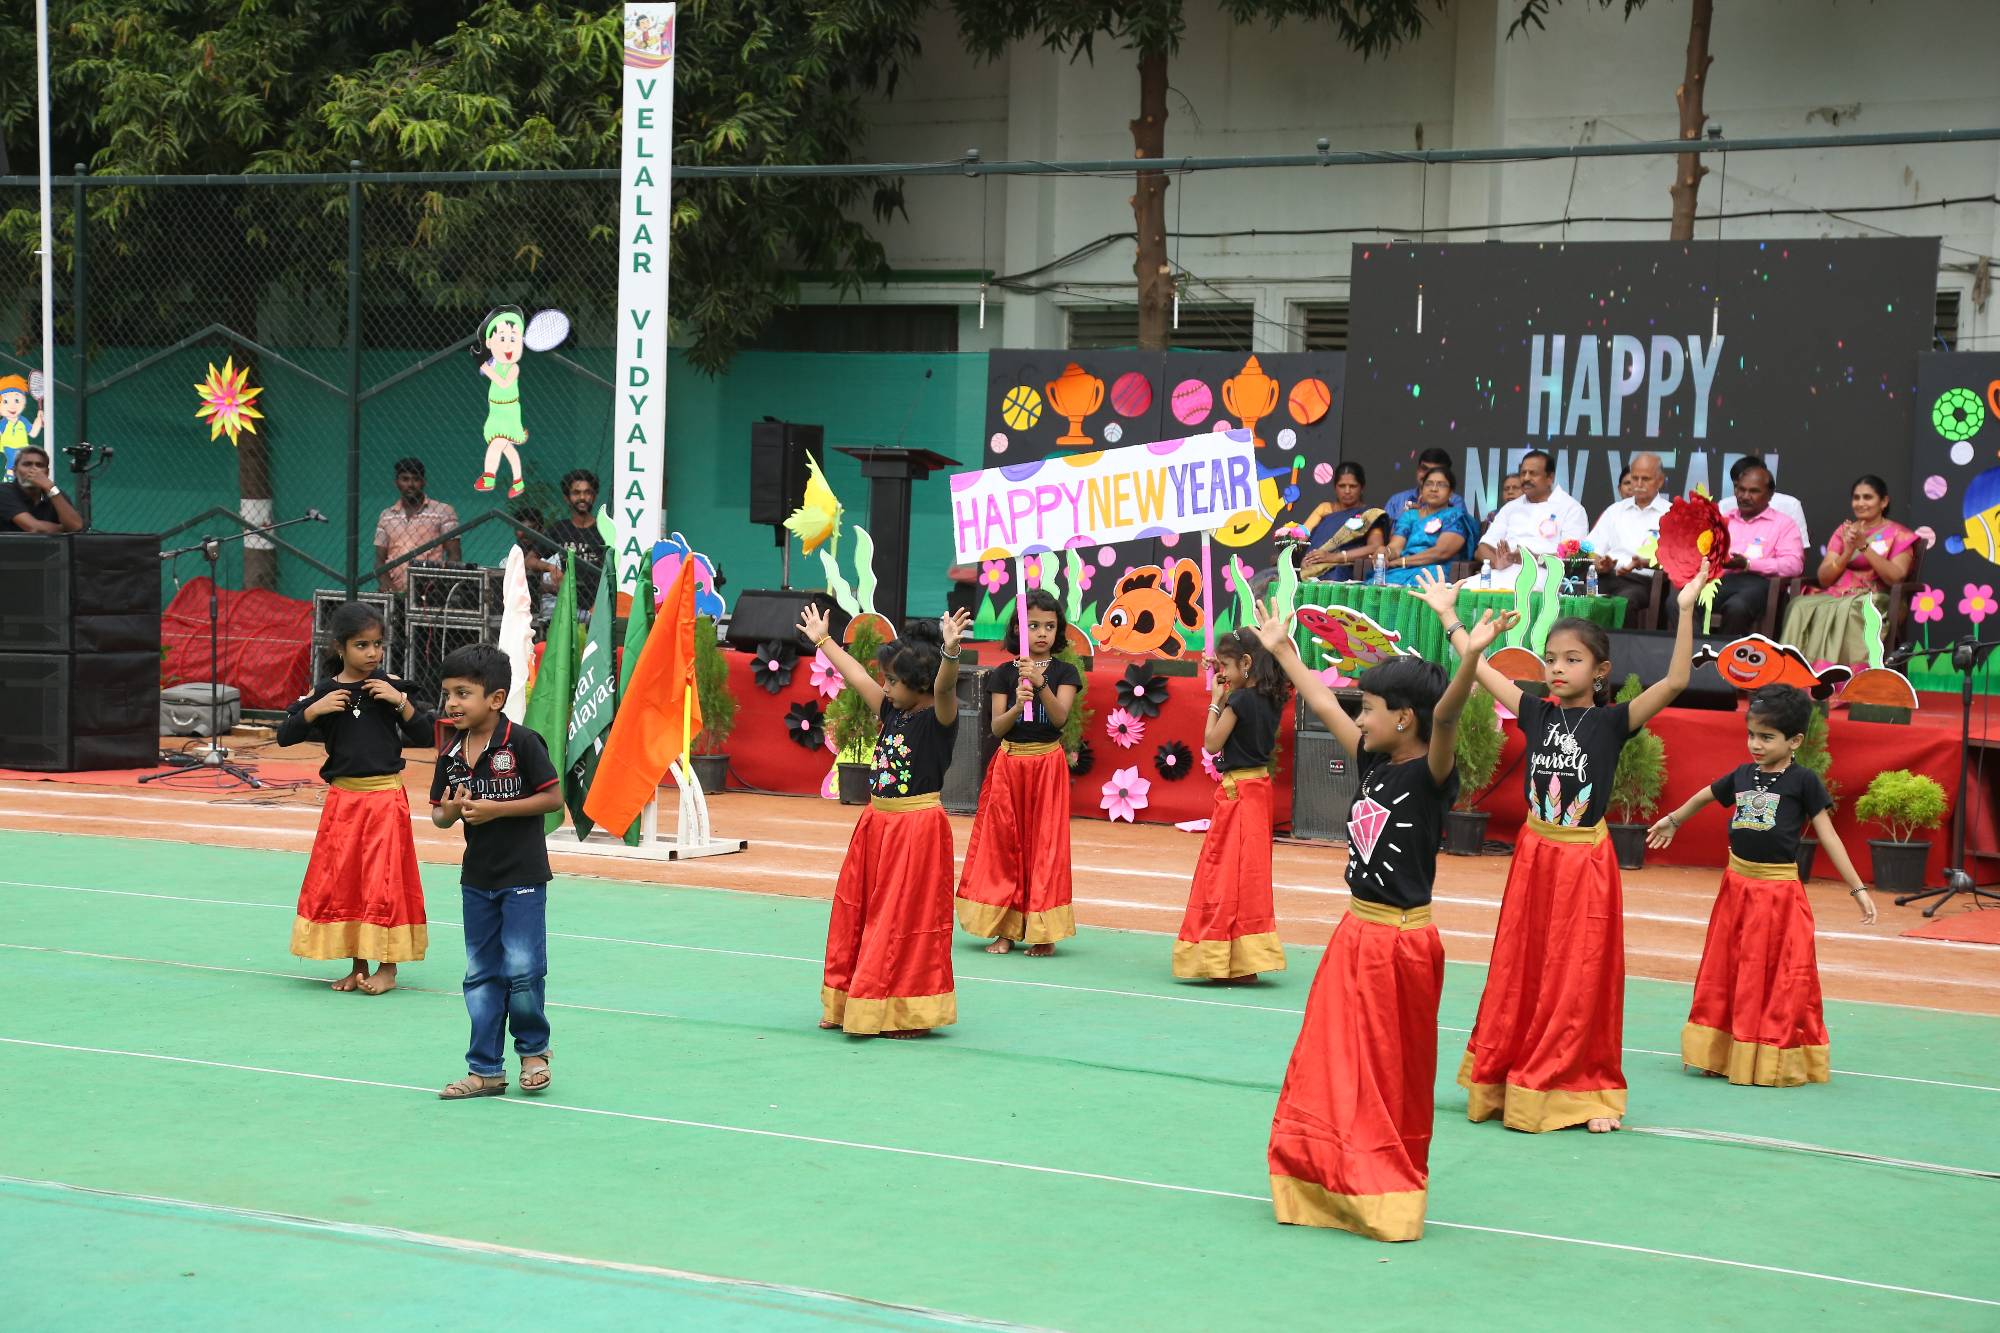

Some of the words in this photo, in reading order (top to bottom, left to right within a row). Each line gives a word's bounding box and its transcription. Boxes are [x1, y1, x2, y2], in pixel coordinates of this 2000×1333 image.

[632, 79, 657, 273] VELALAR
[1527, 334, 1725, 438] HAPPY
[622, 309, 651, 584] VIDYALAYAA
[956, 480, 1084, 553] HAPPY
[1087, 467, 1168, 531] NEW
[1168, 455, 1252, 517] YEAR
[1531, 747, 1589, 782] yourself
[1543, 722, 1574, 747] Fre
